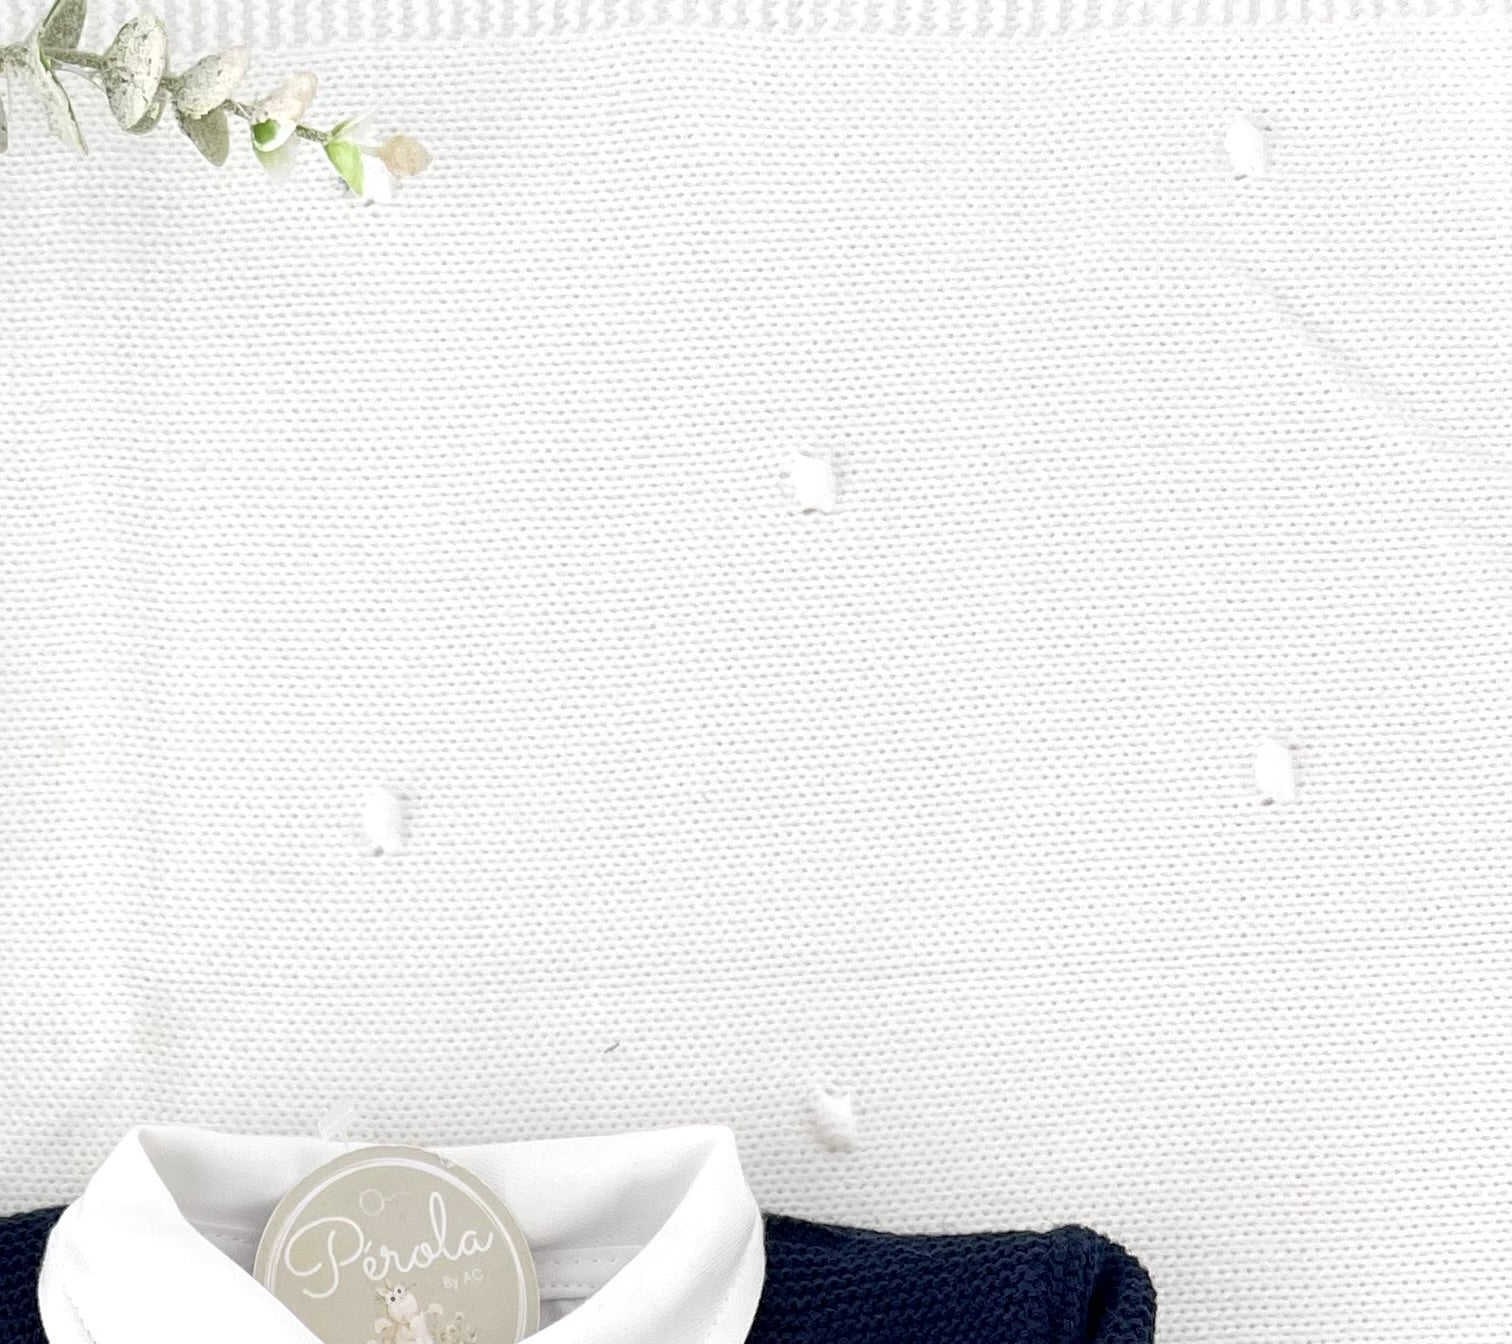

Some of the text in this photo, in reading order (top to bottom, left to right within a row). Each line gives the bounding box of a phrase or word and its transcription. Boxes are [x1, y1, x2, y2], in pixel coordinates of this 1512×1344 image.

[283, 1191, 494, 1299] Pérola
[441, 1267, 484, 1292] By AC
